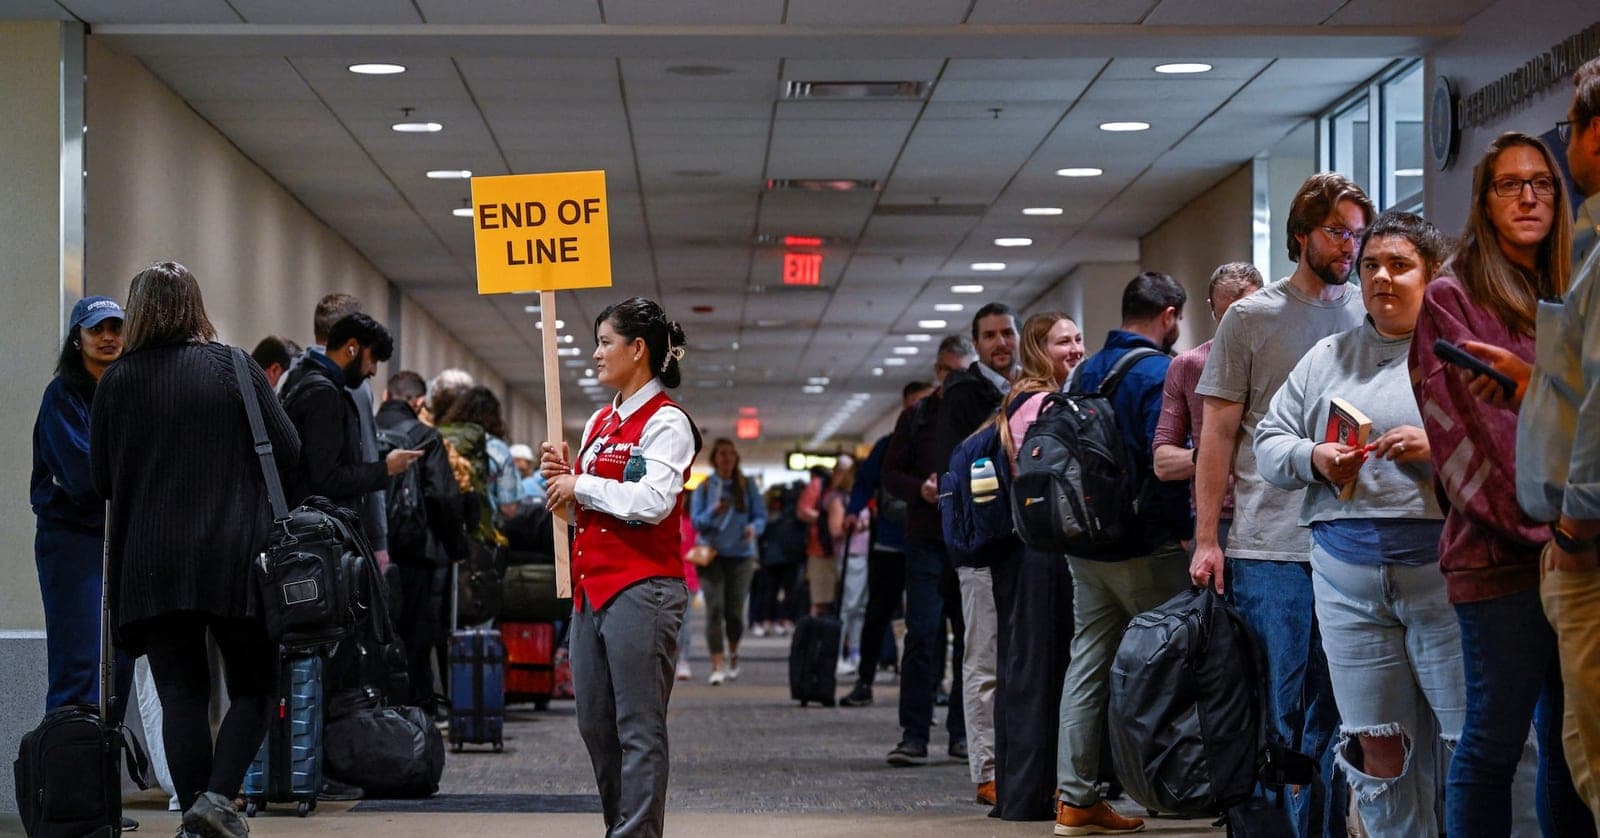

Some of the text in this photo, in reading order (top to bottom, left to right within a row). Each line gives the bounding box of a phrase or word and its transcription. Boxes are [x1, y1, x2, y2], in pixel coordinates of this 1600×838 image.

[1458, 72, 1519, 130] DEFENDING
[1523, 54, 1546, 94] OUR
[480, 198, 600, 229] END OF
[507, 237, 580, 265] LINE
[783, 253, 823, 285] EXIT
